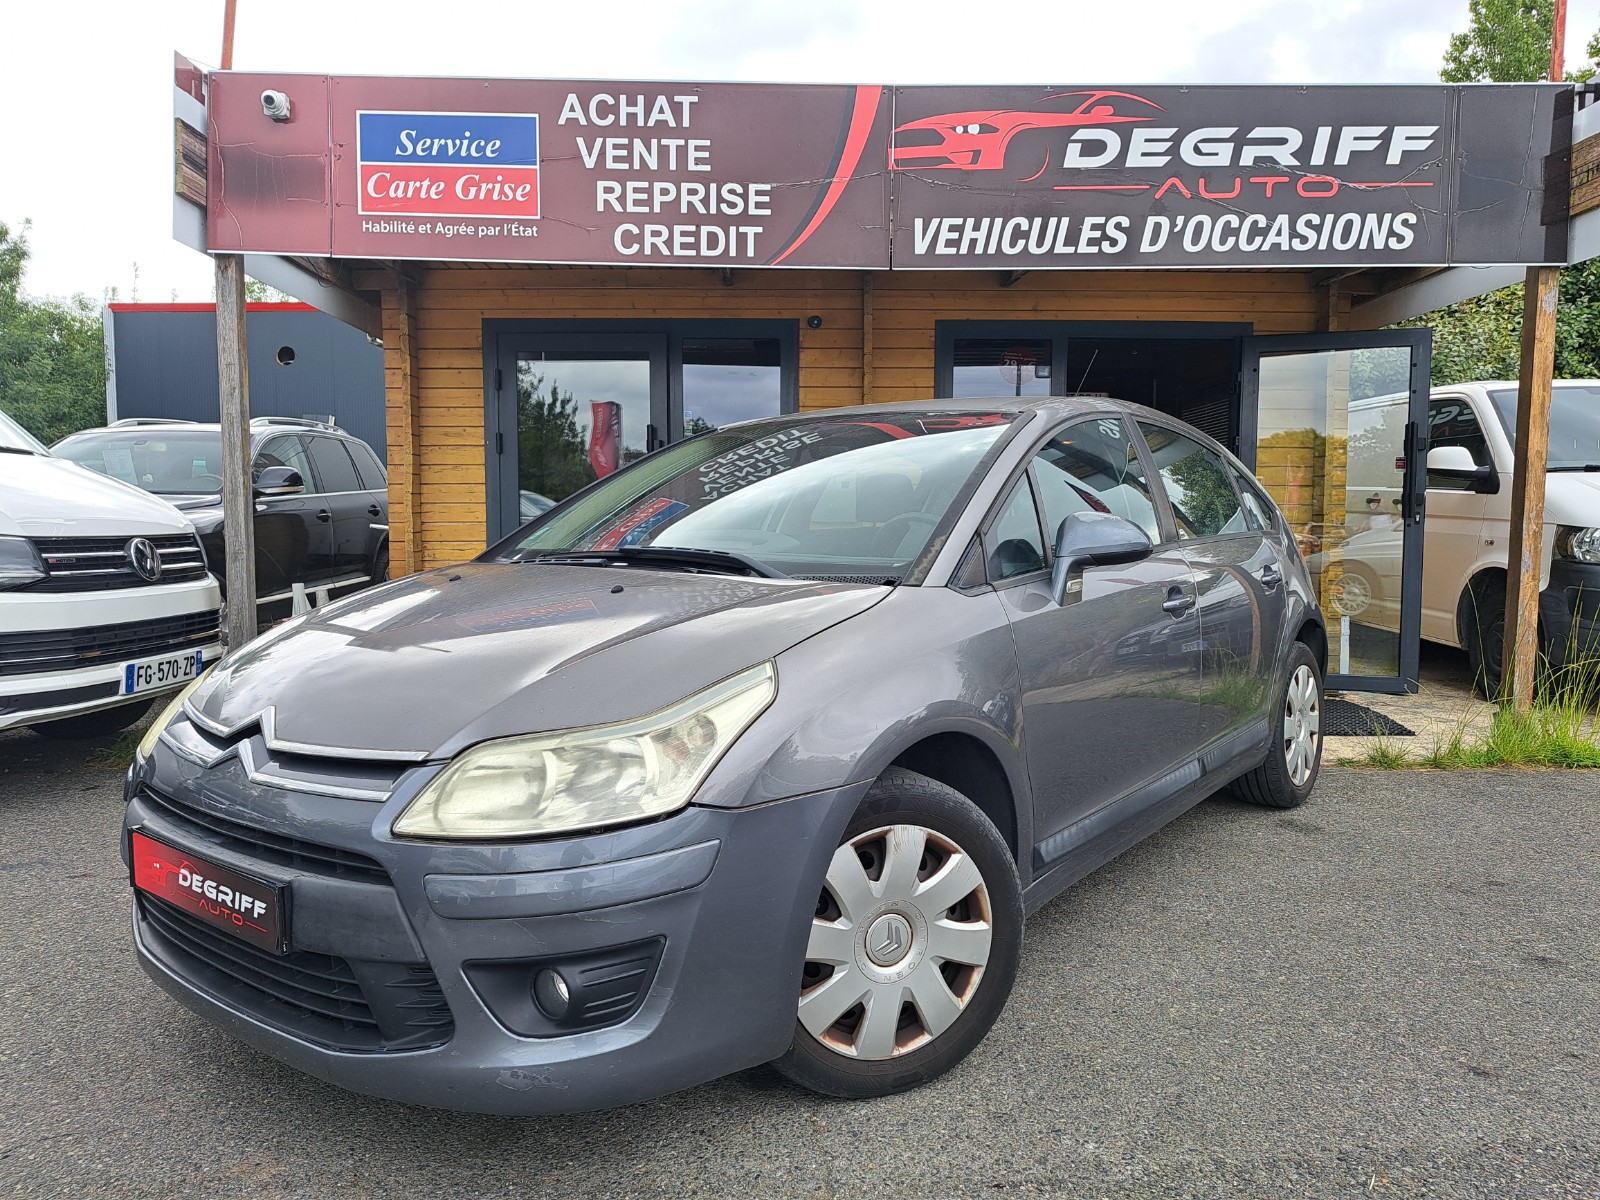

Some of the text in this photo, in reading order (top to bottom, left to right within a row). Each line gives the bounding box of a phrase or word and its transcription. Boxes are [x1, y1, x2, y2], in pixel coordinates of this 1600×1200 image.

[557, 93, 698, 128] ACHAT
[395, 129, 501, 157] Service
[576, 136, 711, 171] VENTE
[1063, 126, 1440, 168] DEGRIFF
[367, 172, 532, 201] Carte Grise
[596, 180, 772, 216] REPRISE
[1154, 176, 1339, 199] AUTO
[362, 220, 538, 238] Habilité et Agrée par l'État
[613, 223, 763, 257] CREDIT
[914, 212, 1418, 255] VEHICULES D'OCCASIONS
[136, 655, 196, 687] FG-570-ZP
[178, 868, 267, 919] DEGRIFF
[198, 898, 243, 926] AUTO
